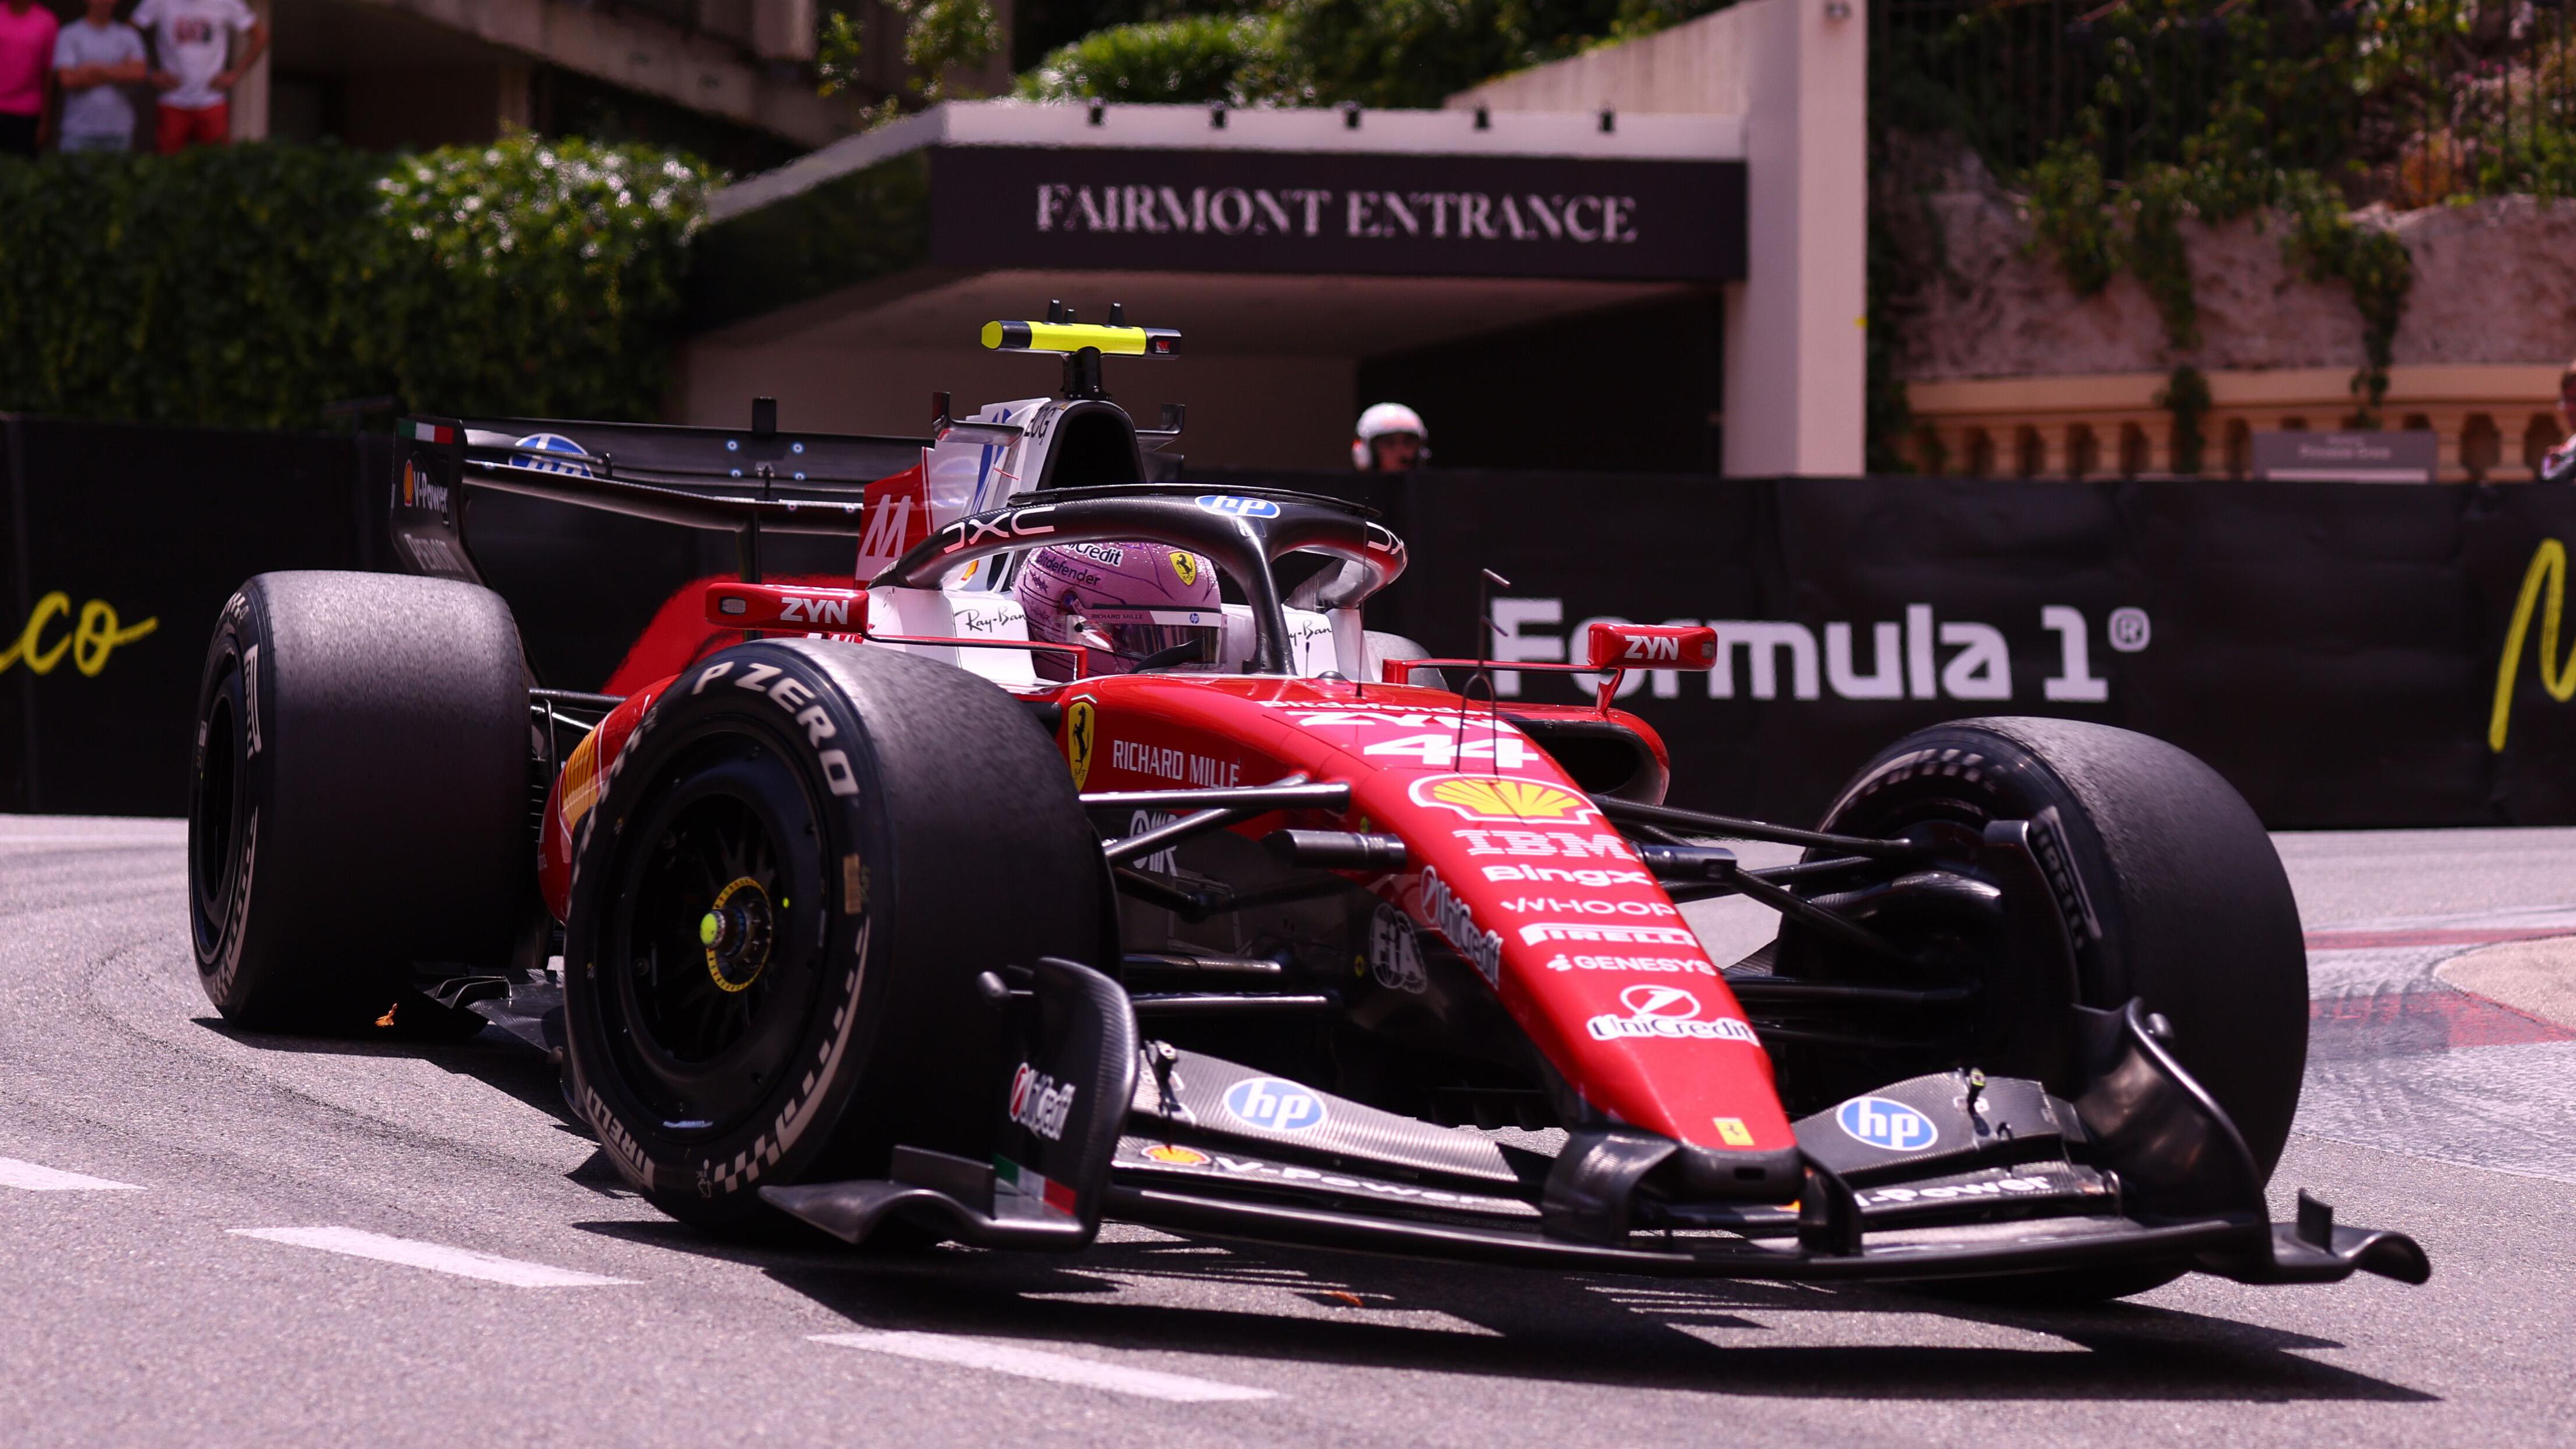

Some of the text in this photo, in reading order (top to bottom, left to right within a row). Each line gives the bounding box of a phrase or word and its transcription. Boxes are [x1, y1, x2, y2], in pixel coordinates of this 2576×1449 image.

[1036, 184, 1637, 242] FAIRMONT ENTRANCE
[413, 471, 448, 514] V-Power
[1035, 551, 1102, 586] Bitdefender
[780, 596, 850, 625] ZYN
[955, 605, 1027, 633] Ray-Ban
[1624, 635, 1680, 661] ZYN
[1256, 700, 1495, 717] Bitdefender
[1284, 710, 1522, 734] ZYN
[692, 661, 860, 796] P ZERO
[1112, 739, 1184, 780] RICHARD
[1363, 734, 1539, 768] 44
[1452, 829, 1640, 863] IBM
[1500, 898, 1678, 916] WHOOP
[1371, 915, 1424, 982] FIA
[1519, 922, 1699, 948] PIRELLI
[1573, 955, 1717, 976] GENESYS
[1588, 1014, 1760, 1045] UniCredit
[1242, 1078, 1313, 1130] hp
[1858, 1098, 1921, 1150] hp
[1215, 1156, 1488, 1204] V-Power
